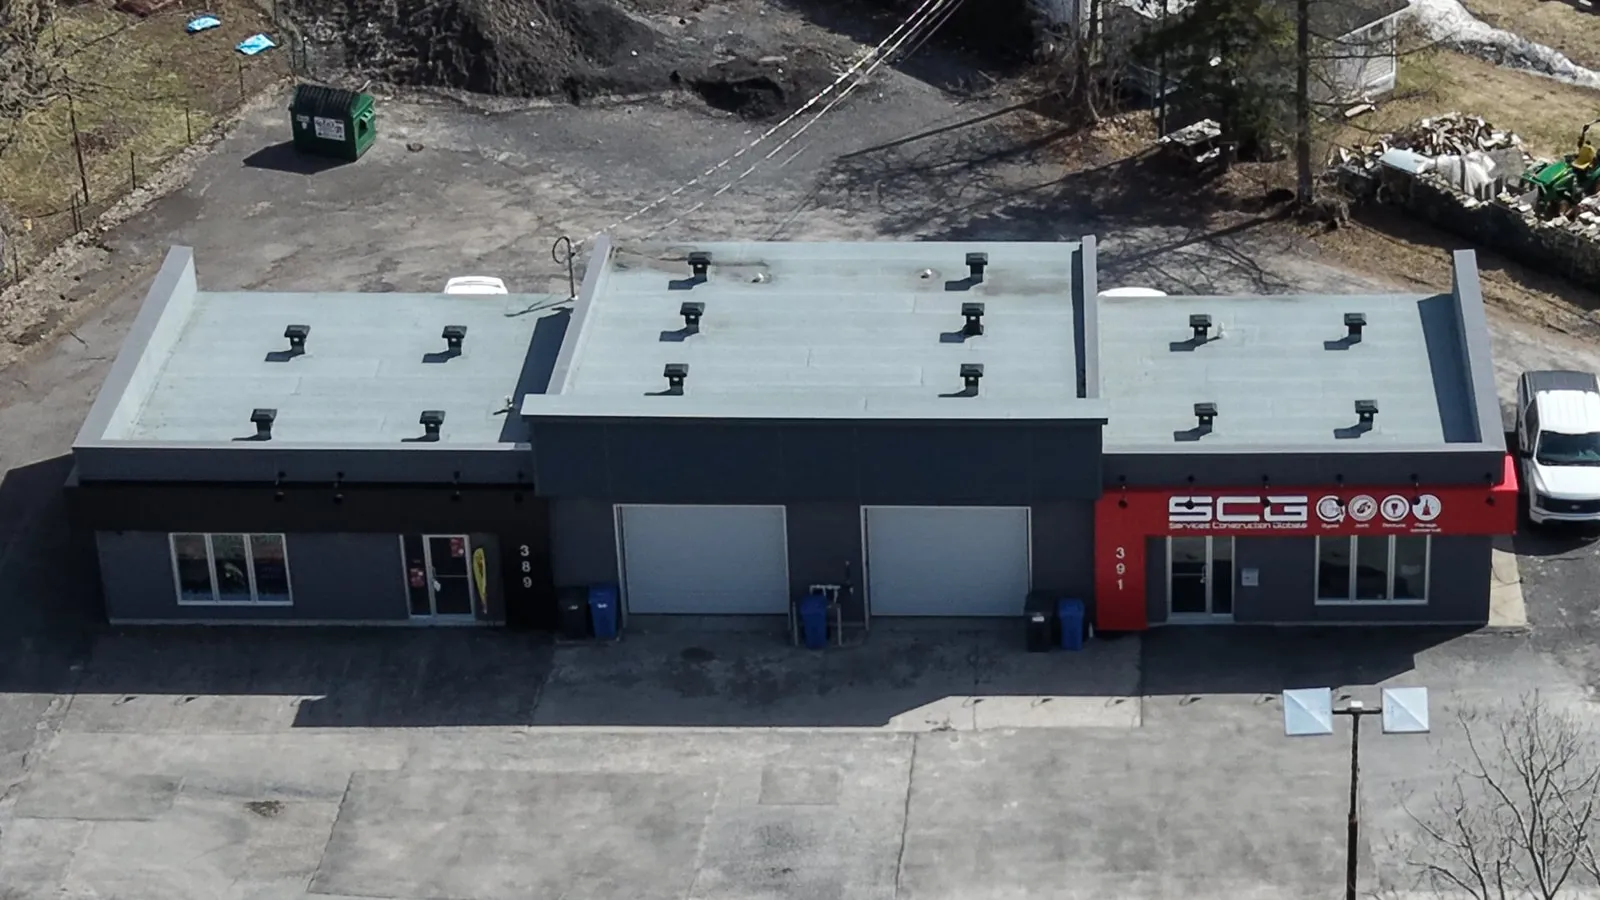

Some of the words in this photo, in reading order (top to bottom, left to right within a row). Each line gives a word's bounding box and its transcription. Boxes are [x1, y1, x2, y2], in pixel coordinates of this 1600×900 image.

[1169, 496, 1308, 522] SCG
[520, 545, 532, 588] 389
[1115, 547, 1125, 590] 391
